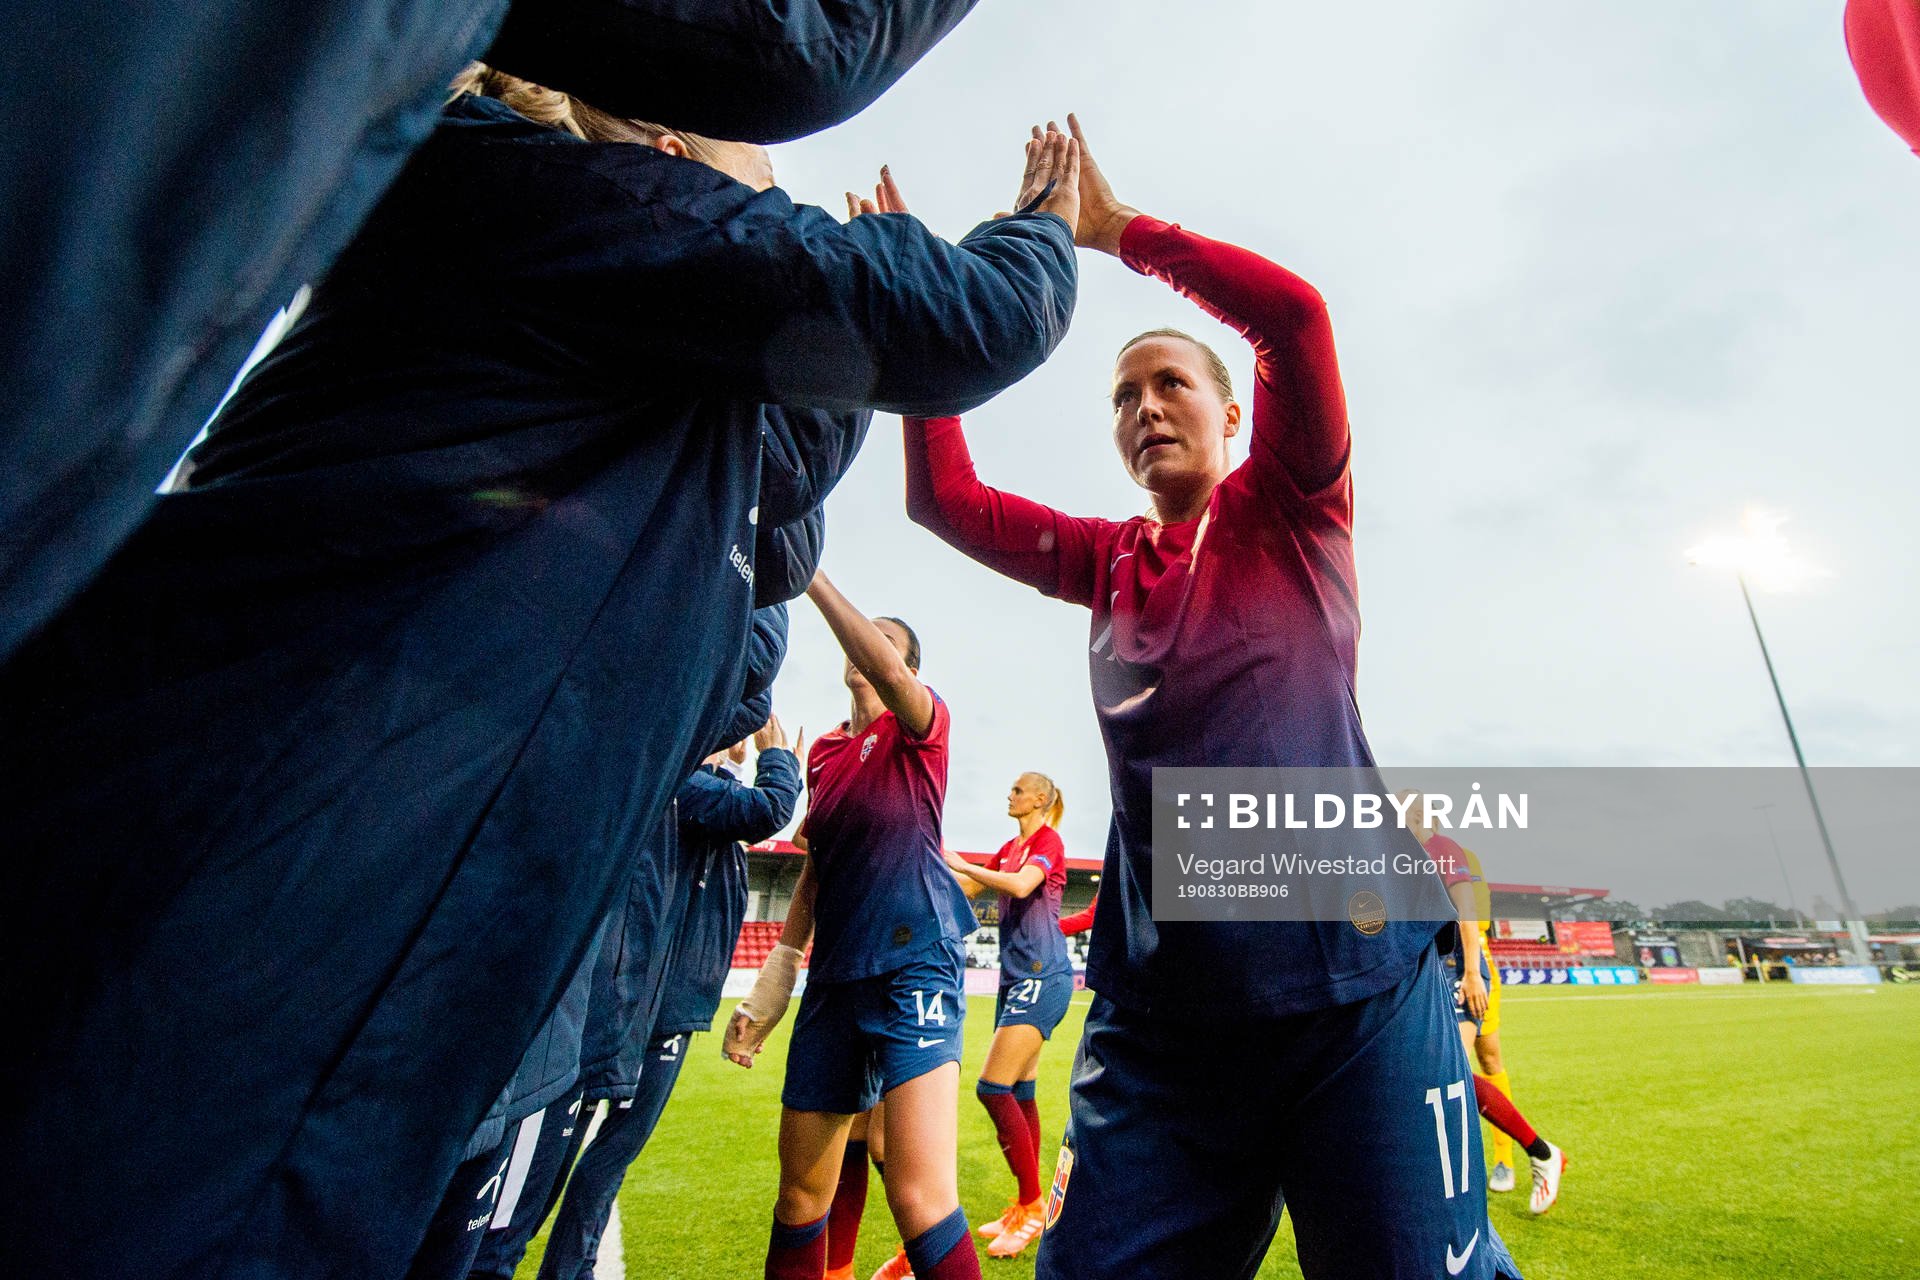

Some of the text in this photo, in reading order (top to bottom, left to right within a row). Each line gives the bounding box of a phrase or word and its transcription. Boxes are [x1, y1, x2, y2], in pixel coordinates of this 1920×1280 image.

[911, 989, 947, 1027] 14
[1017, 979, 1042, 1004] 21
[1425, 1079, 1469, 1199] 17
